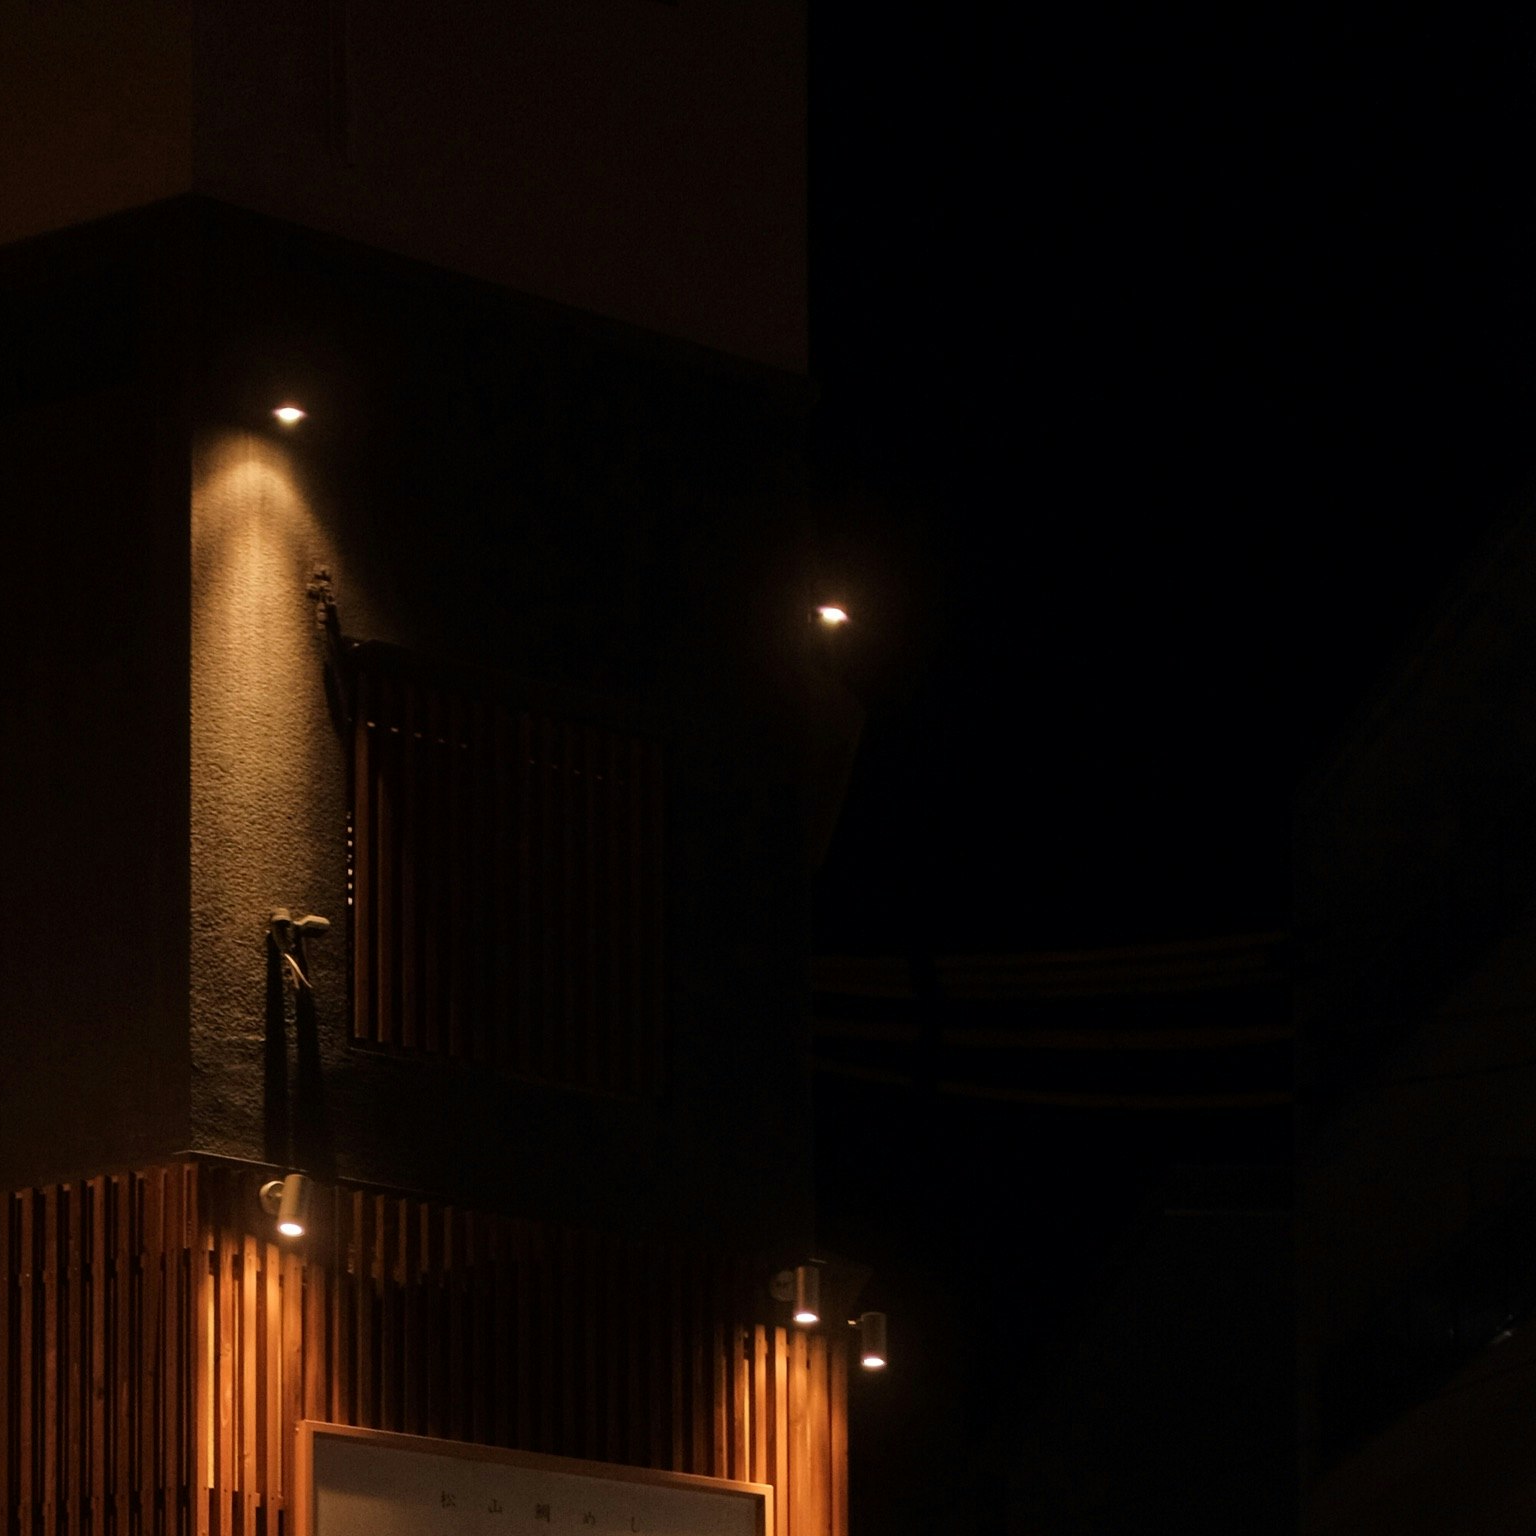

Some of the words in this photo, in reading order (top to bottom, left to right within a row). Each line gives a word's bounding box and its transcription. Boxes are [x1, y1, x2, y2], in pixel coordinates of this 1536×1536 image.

[440, 1489, 640, 1533] 松山鯛めし
